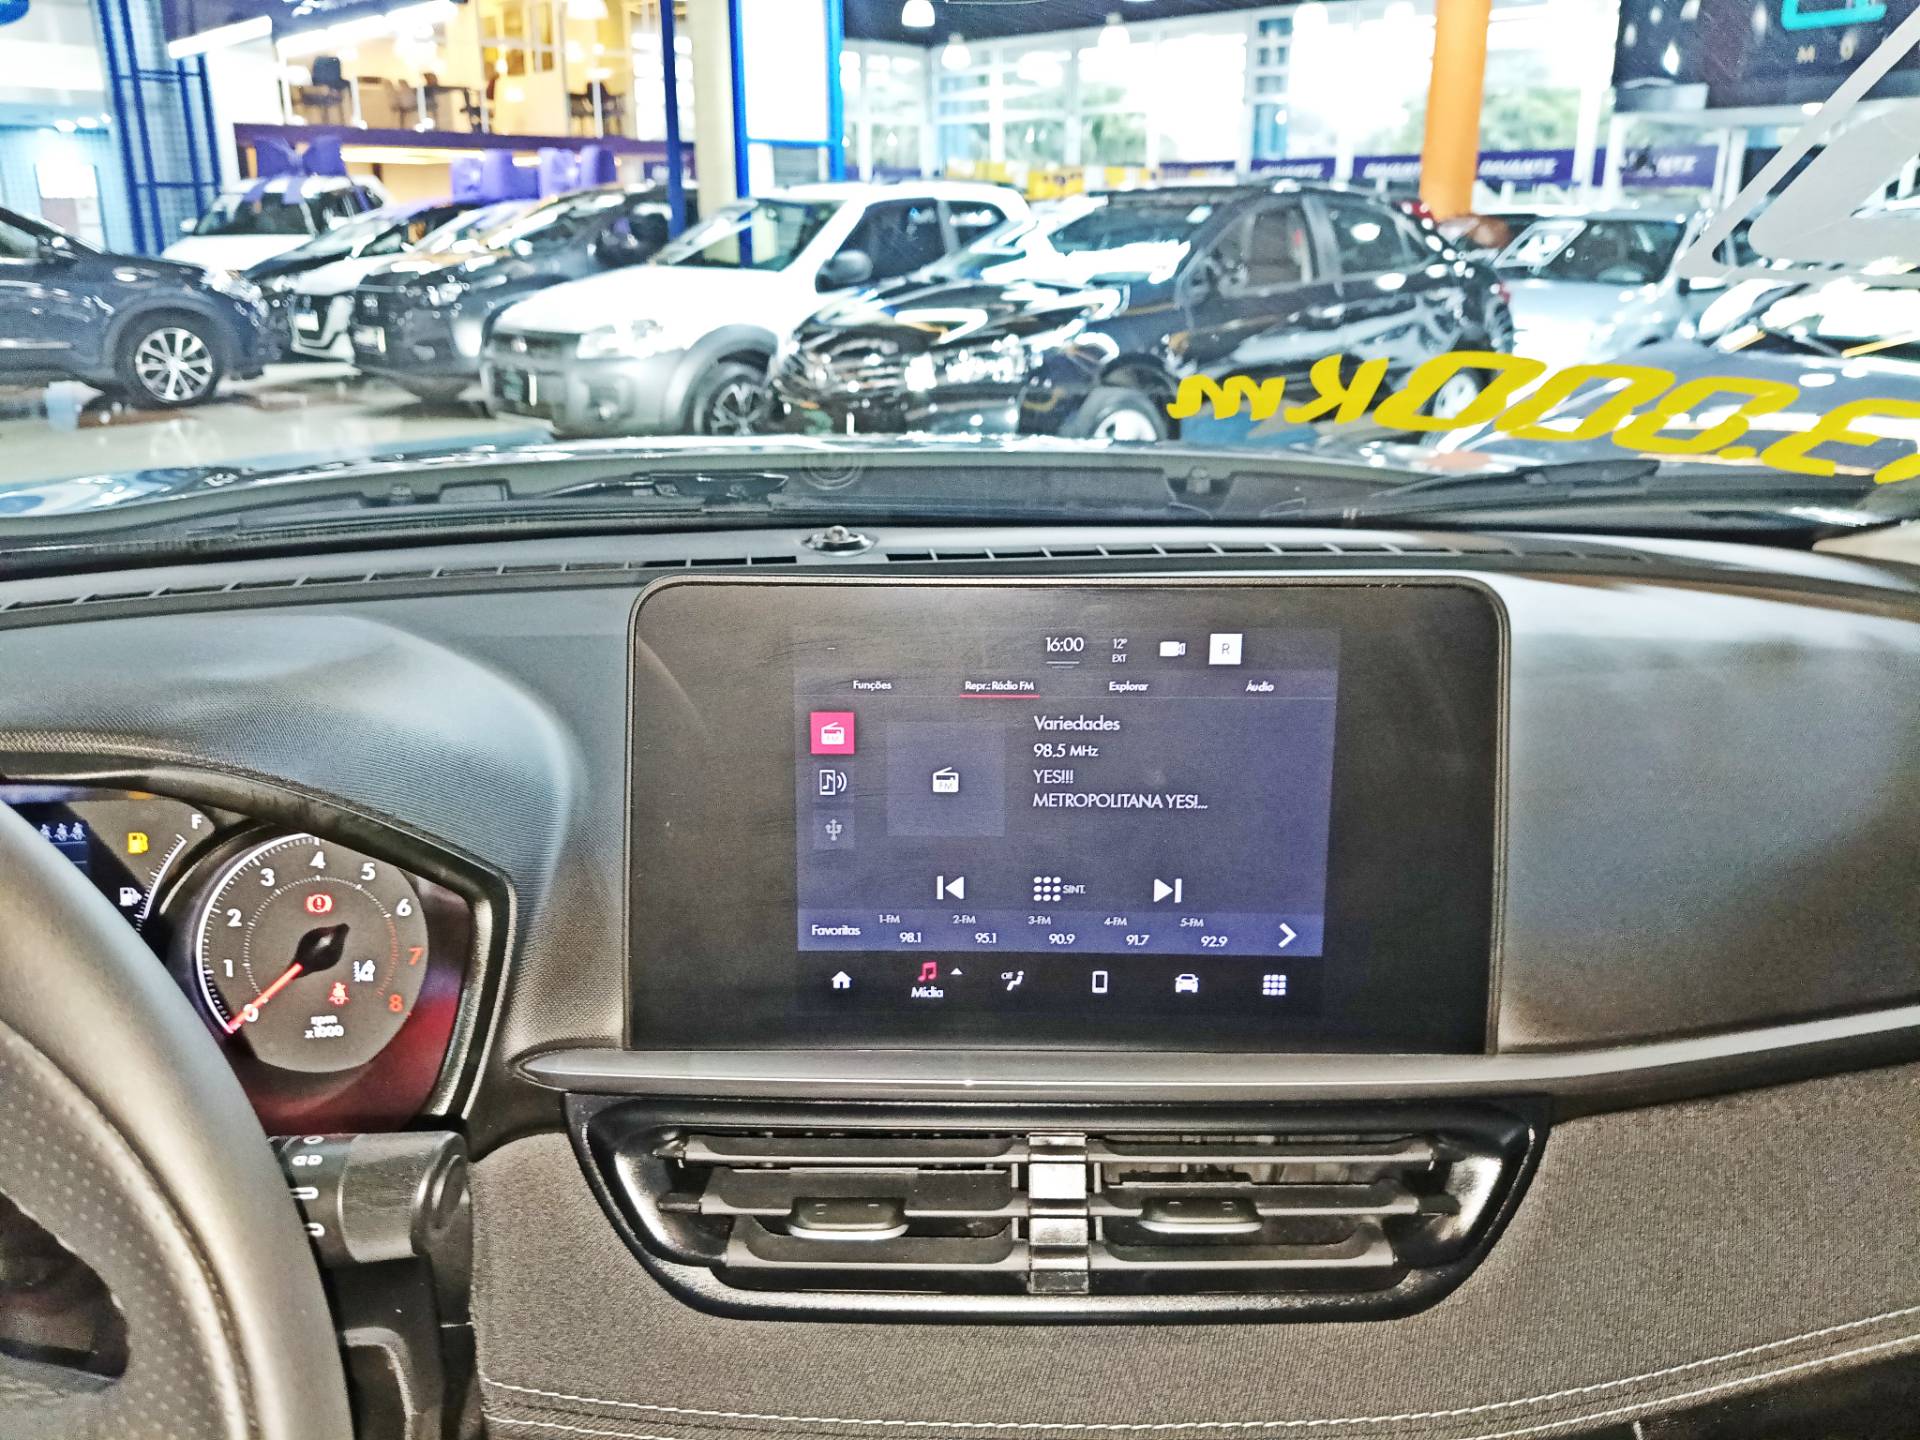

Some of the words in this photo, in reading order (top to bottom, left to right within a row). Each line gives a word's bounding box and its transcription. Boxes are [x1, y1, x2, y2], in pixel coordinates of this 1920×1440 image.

[1045, 636, 1085, 652] 16:00
[1221, 643, 1231, 655] R
[1112, 654, 1127, 663] EXT
[852, 680, 893, 692] Funções
[992, 680, 1018, 691] Rádio
[1019, 680, 1035, 691] FM
[1109, 680, 1149, 693] Explorar
[1245, 680, 1275, 692] Áudio
[1034, 715, 1120, 731] Variedades
[1033, 743, 1066, 758] 98.5
[1069, 745, 1099, 757] MHz
[1033, 769, 1074, 784] YES!!!
[1032, 793, 1163, 808] METROPOLITANA
[191, 813, 202, 829] F
[309, 851, 326, 869] 4
[260, 868, 275, 886] 3
[360, 863, 376, 880] 5
[396, 898, 412, 916] 6
[227, 908, 242, 927] 2
[878, 914, 901, 924] 1-FM
[952, 914, 976, 925] 2-FM
[1028, 916, 1051, 926] 3-FM
[1104, 917, 1127, 927] 4-FM
[1179, 918, 1204, 928] 5-FM
[811, 924, 861, 937] Favoritas
[899, 932, 922, 944] 98.1
[975, 933, 997, 945] 95.1
[1048, 933, 1075, 945] 90.9
[1125, 934, 1150, 946] 91.7
[1200, 936, 1228, 948] 92.9
[409, 947, 423, 965] 7
[223, 959, 234, 977] 1
[911, 986, 943, 998] Mídia
[388, 994, 403, 1012] 8
